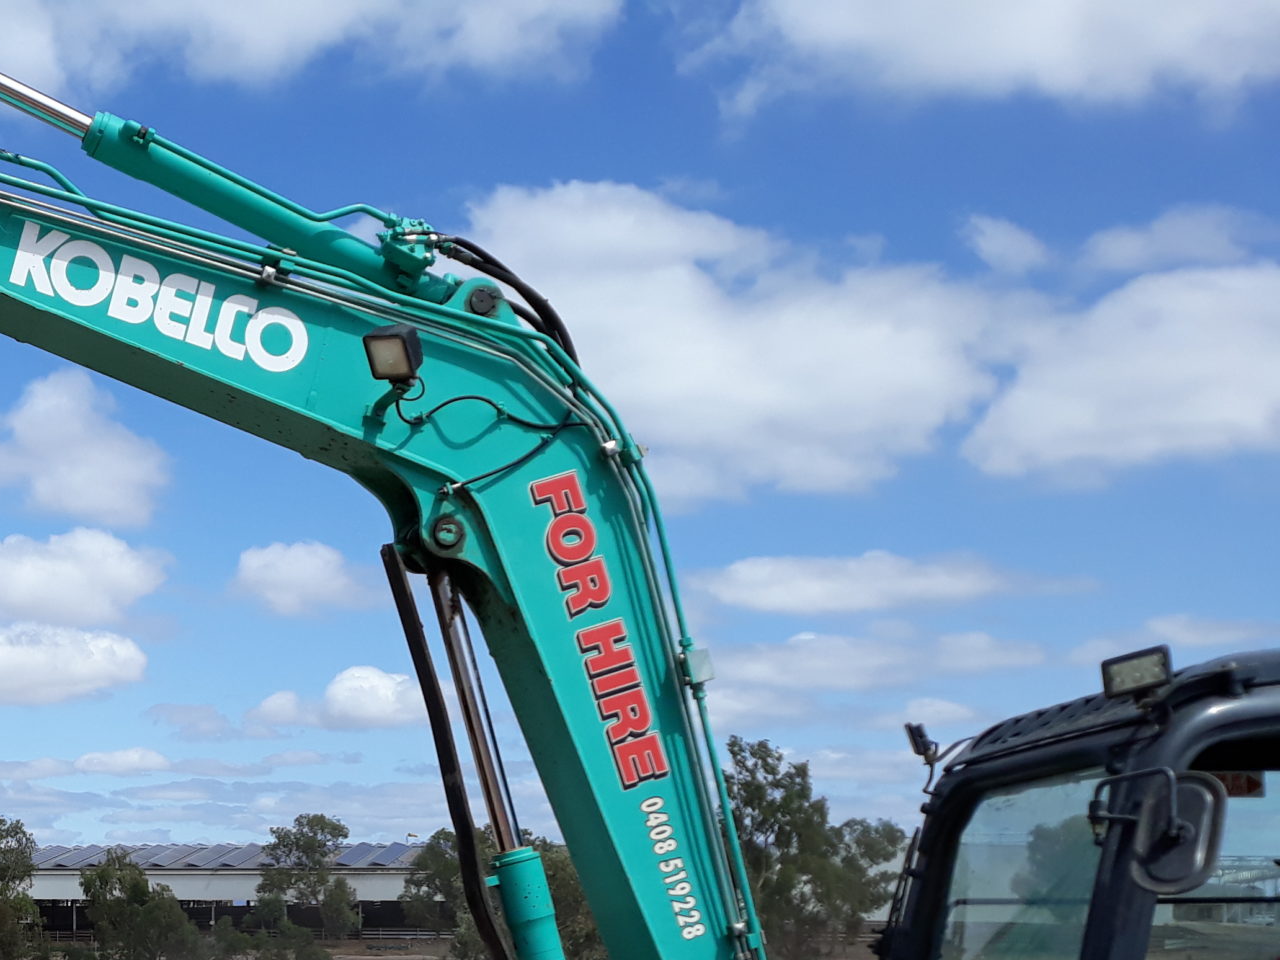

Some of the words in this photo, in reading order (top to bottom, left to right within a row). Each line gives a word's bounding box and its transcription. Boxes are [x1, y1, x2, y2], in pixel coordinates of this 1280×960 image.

[9, 221, 309, 373] KOBELCO
[529, 469, 612, 620] FOR
[576, 617, 670, 791] HIRE
[639, 795, 677, 856] 0408
[657, 855, 706, 942] 519228
